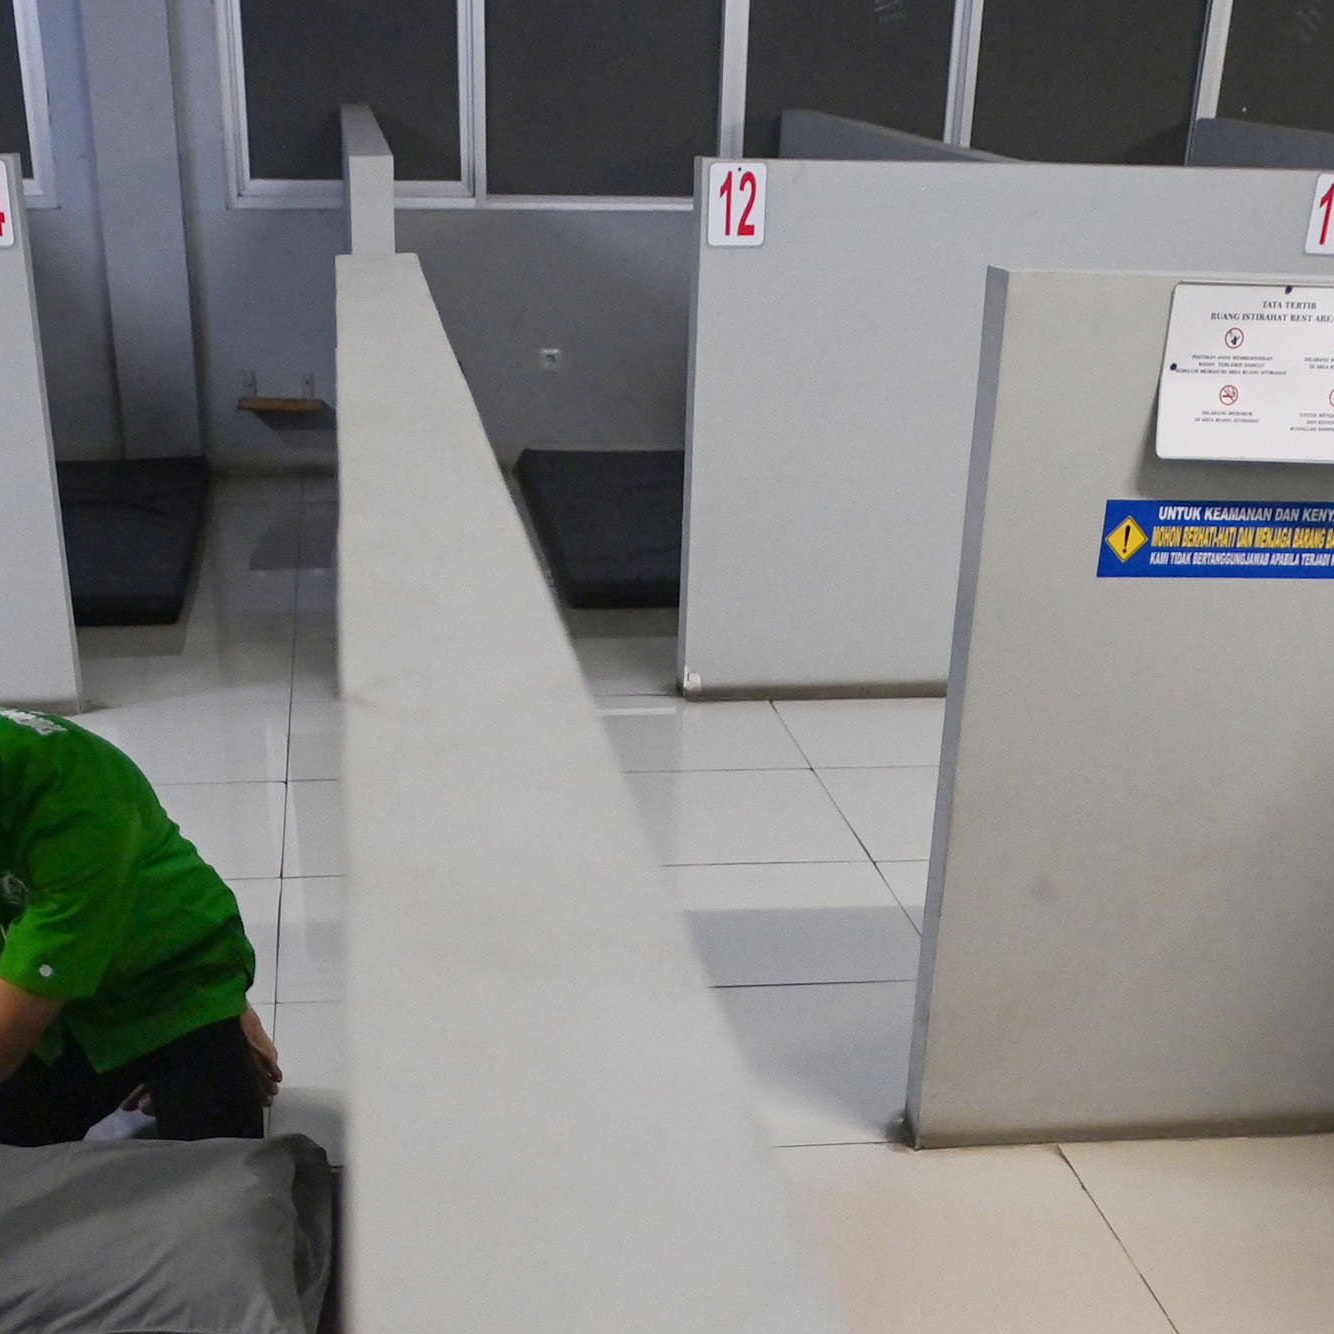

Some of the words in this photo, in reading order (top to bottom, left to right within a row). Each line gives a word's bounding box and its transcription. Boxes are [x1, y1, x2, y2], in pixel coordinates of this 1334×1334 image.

[719, 170, 757, 236] 12
[1263, 300, 1283, 309] TATA
[1285, 301, 1317, 310] TERTIB
[1210, 312, 1240, 321] RUANG
[1242, 313, 1287, 322] ISTIRAHAT
[1290, 314, 1313, 323] REST
[1158, 506, 1202, 520] UNTUK
[1204, 506, 1272, 521] KEAMANAN
[1275, 507, 1300, 521] DAN
[1151, 526, 1182, 547] MOHON
[1181, 526, 1237, 548] BERHATI-HATI
[1236, 526, 1255, 548] DAN
[1254, 527, 1293, 549] MENJAGA
[1292, 527, 1327, 549] BARANG
[1149, 551, 1169, 565] KAMI
[1170, 551, 1192, 565] TIDAK
[1192, 552, 1270, 566] BERTANGGUNGJAWAB
[1269, 553, 1300, 566] APABILA
[1301, 553, 1331, 566] TERJADI
